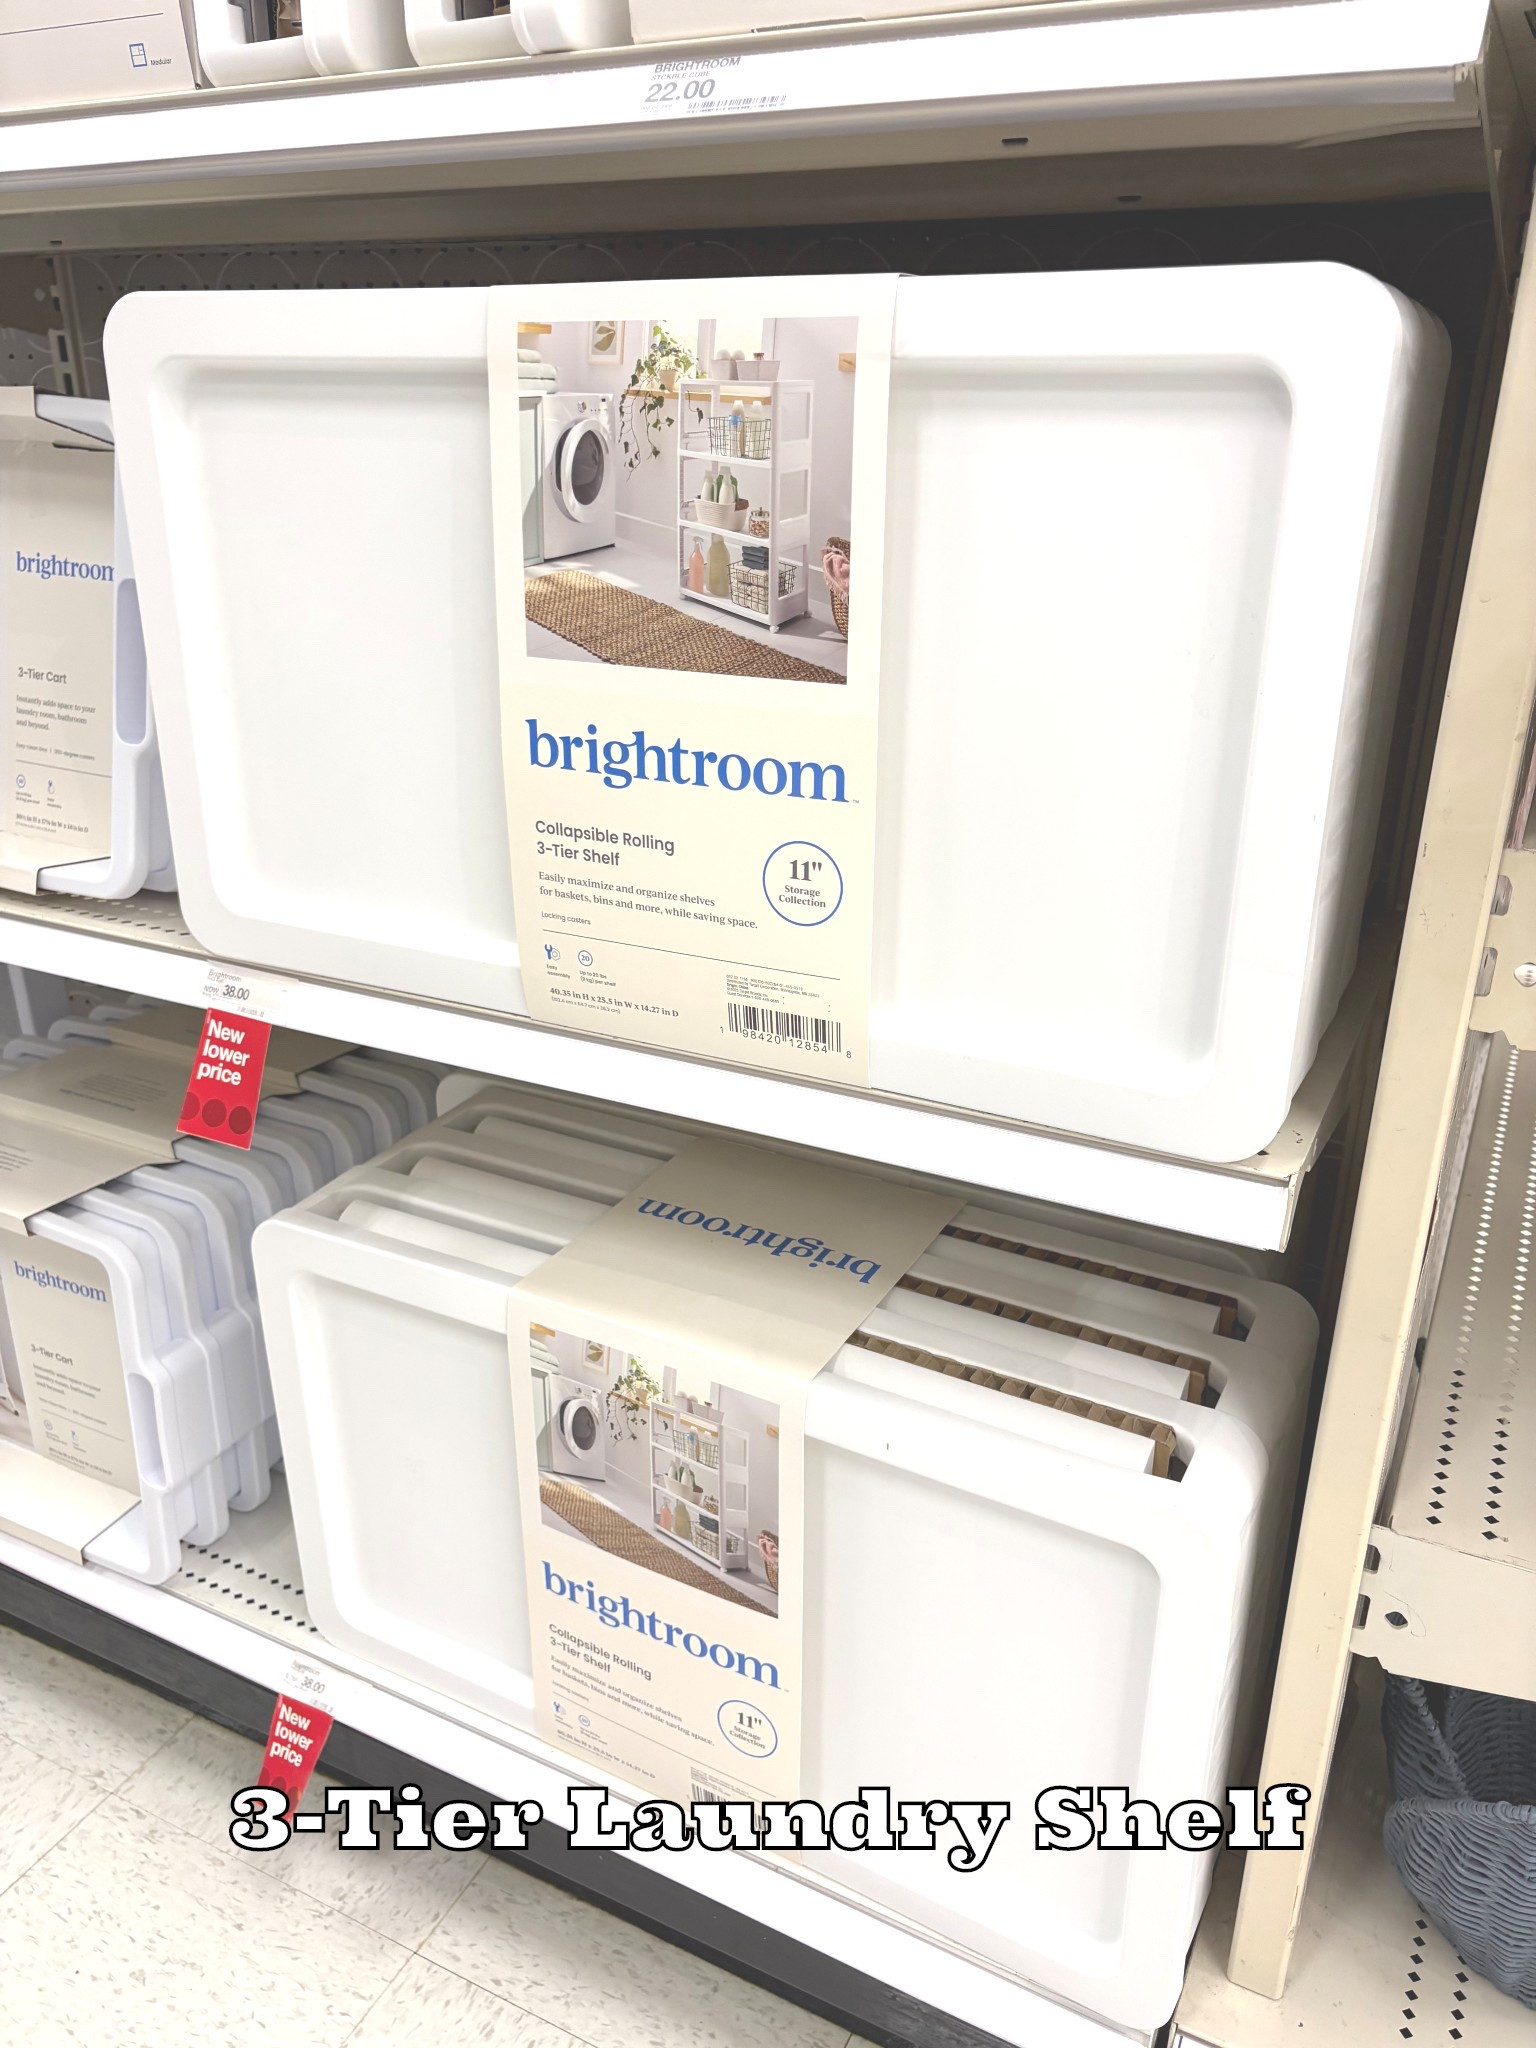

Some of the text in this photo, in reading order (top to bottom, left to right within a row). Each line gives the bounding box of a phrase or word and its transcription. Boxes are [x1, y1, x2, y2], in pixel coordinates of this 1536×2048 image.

[654, 57, 741, 73] BRIGHTROOM
[644, 78, 716, 103] 22.00
[18, 666, 67, 684] 3-Tier Cart
[525, 718, 849, 802] brightroom
[535, 820, 675, 856] Collapsible Rolling
[537, 841, 620, 866] 3-Tier Shelf
[788, 859, 822, 882] 11"
[538, 871, 716, 906] Easily maximize and organize shelves
[778, 894, 826, 908] Collection
[784, 885, 820, 898] Storage
[540, 886, 758, 929] for baskets, bins and more, while saving space.
[541, 912, 591, 925] Locking casters
[581, 954, 590, 962] 20
[208, 969, 242, 982] Brightroom
[204, 985, 220, 994] NOW
[222, 984, 250, 1000] 38.00
[550, 988, 572, 997] 40.35
[572, 991, 581, 999] in
[596, 996, 613, 1005] 25.5
[614, 998, 622, 1006] in
[624, 1000, 632, 1008] W
[640, 1004, 660, 1014] 14.27
[662, 1008, 670, 1016] in
[207, 1018, 246, 1045] New
[202, 1039, 250, 1067] lower
[196, 1062, 242, 1086] price
[637, 1197, 882, 1285] brightroom
[14, 1259, 107, 1302] brightroom
[31, 1343, 74, 1366] 3-Tier Cart
[542, 1560, 781, 1690] brightroom
[549, 1623, 652, 1681] Collapsible Rolling
[550, 1636, 611, 1673] 3-Tier Shelf
[278, 1703, 312, 1731] New
[274, 1720, 314, 1751] lower
[730, 1730, 766, 1750] Collection
[269, 1740, 303, 1768] price
